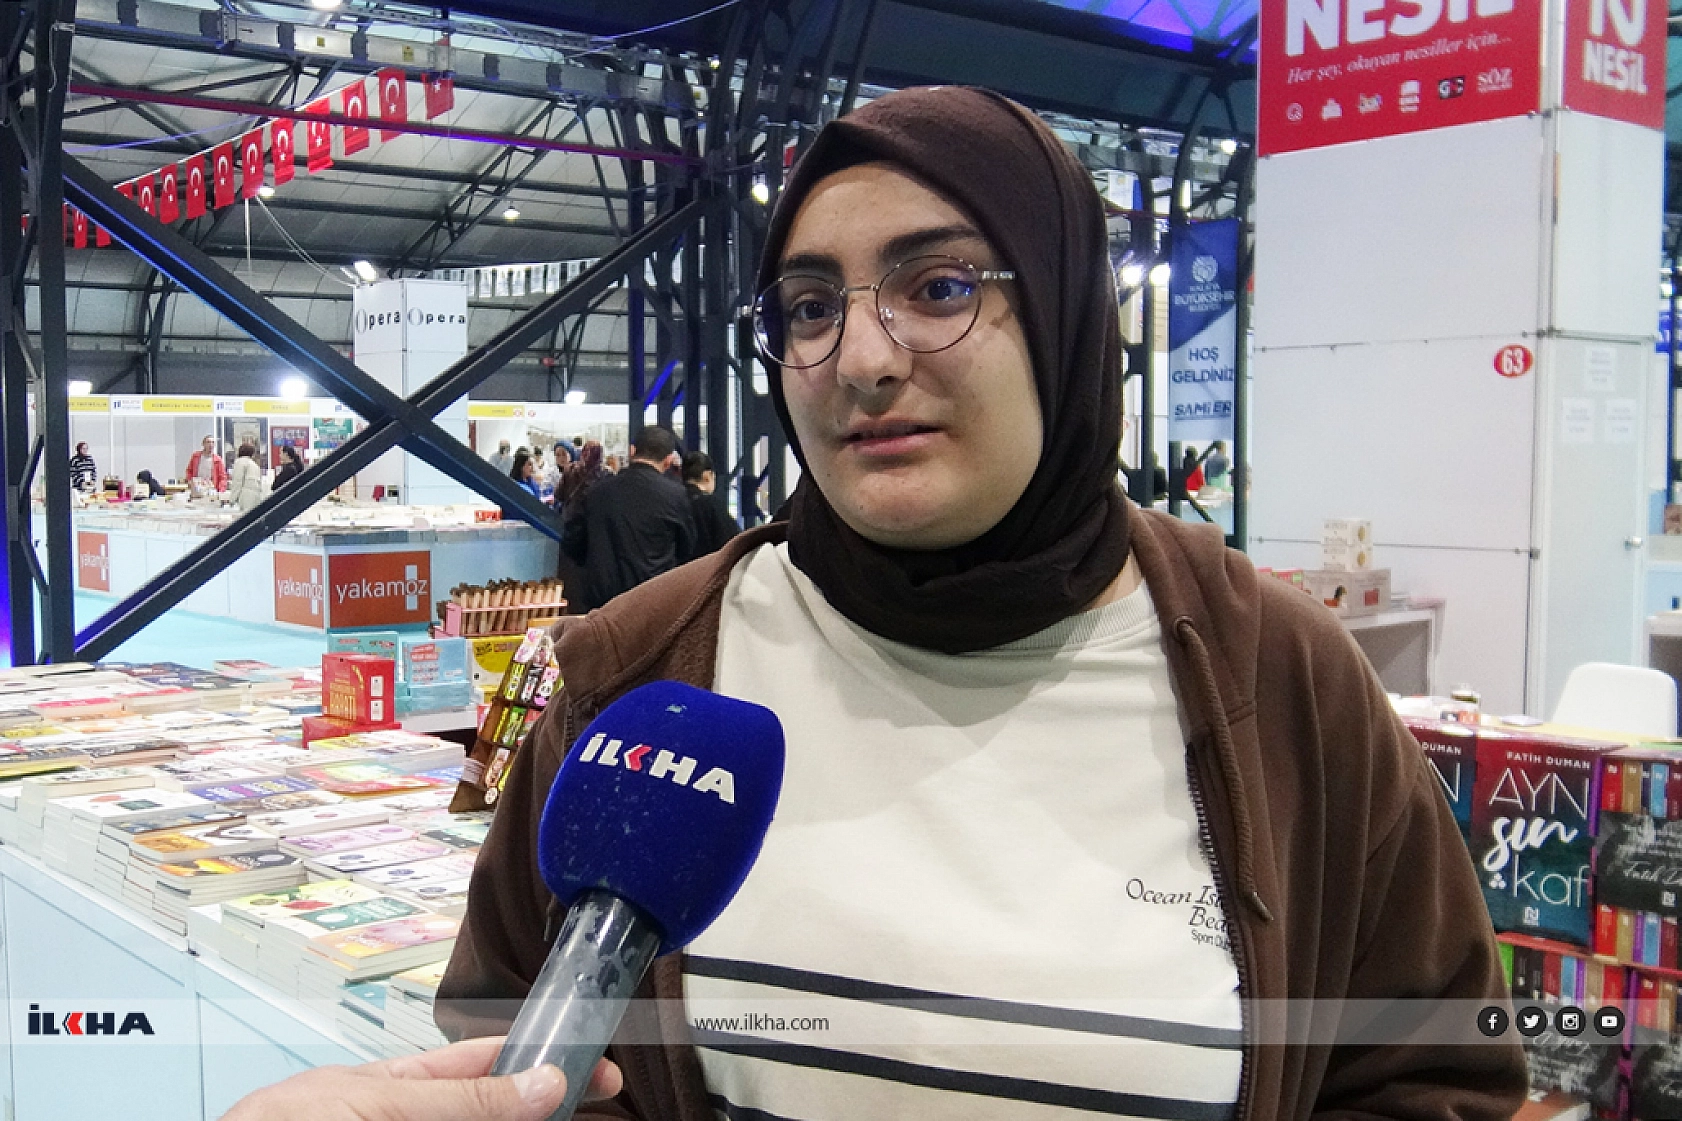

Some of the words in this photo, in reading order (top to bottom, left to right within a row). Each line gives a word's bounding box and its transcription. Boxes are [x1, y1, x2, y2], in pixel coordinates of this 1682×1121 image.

[1347, 52, 1400, 73] okuyan
[1404, 37, 1463, 62] nesiller
[356, 308, 401, 334] Opera
[407, 307, 467, 326] Opera
[1188, 347, 1220, 363] HOŞ
[1503, 347, 1525, 375] 63
[277, 577, 324, 600] yakamoz
[335, 577, 429, 604] yakamoz
[1506, 751, 1542, 764] FATİH
[1546, 756, 1591, 770] DUMAN
[1488, 767, 1589, 821] AYN
[1126, 878, 1192, 905] Ocean
